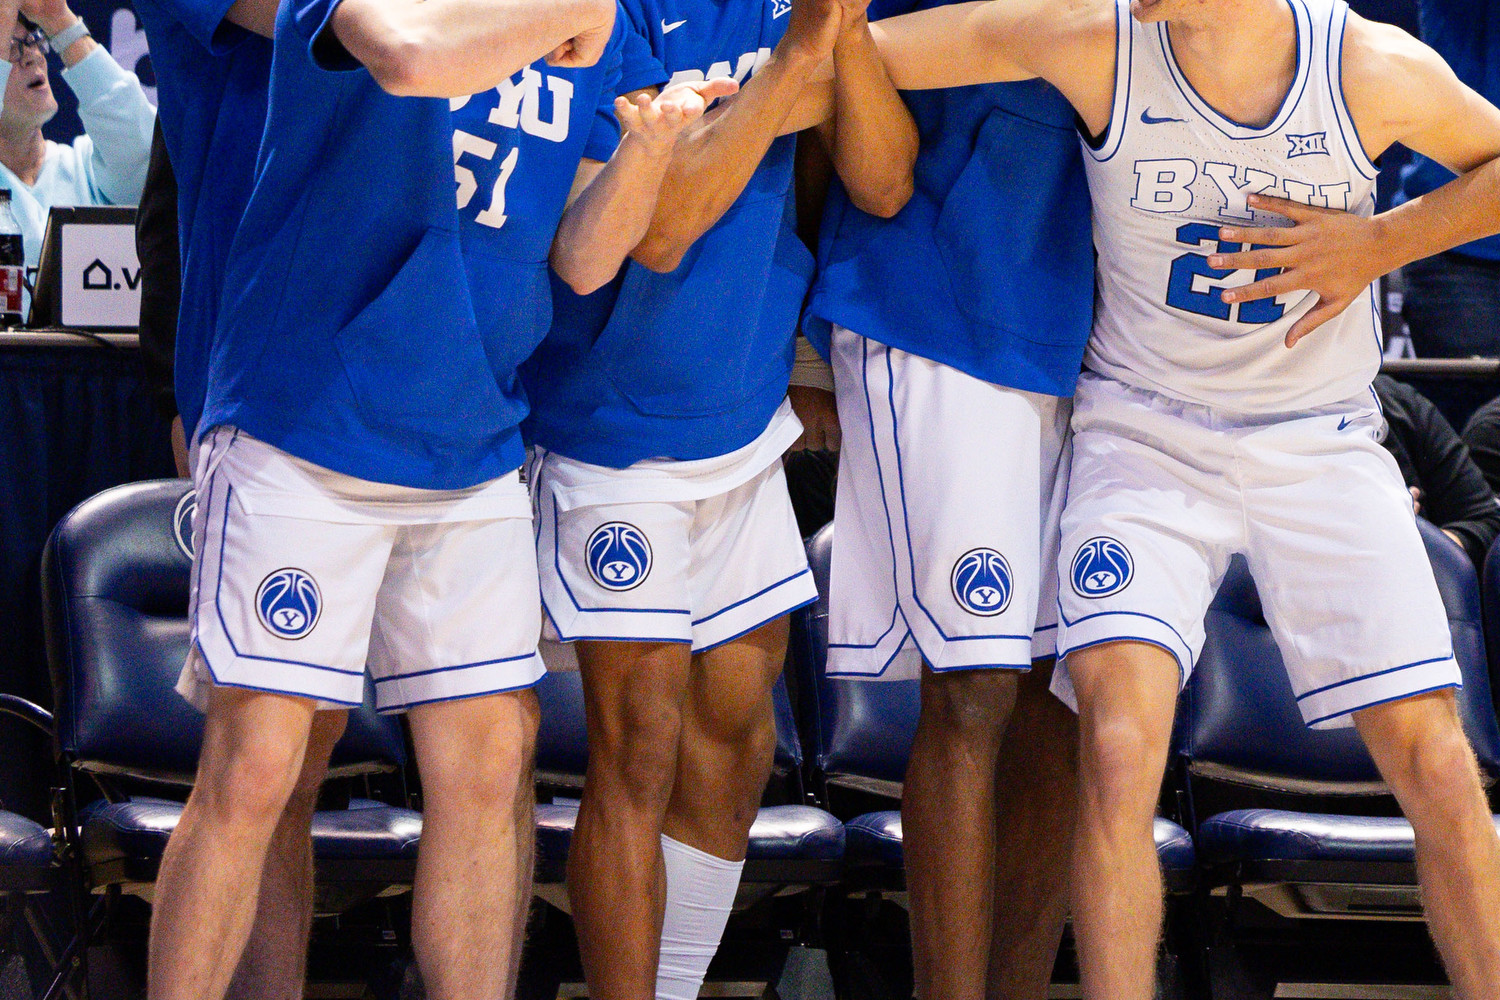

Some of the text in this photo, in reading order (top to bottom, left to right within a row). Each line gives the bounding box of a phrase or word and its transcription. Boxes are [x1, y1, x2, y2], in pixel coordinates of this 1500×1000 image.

[449, 64, 574, 143] YU
[452, 129, 507, 229] 51
[608, 563, 629, 579] Y
[1091, 573, 1111, 588] Y
[975, 589, 996, 604] Y
[280, 610, 300, 627] Y
